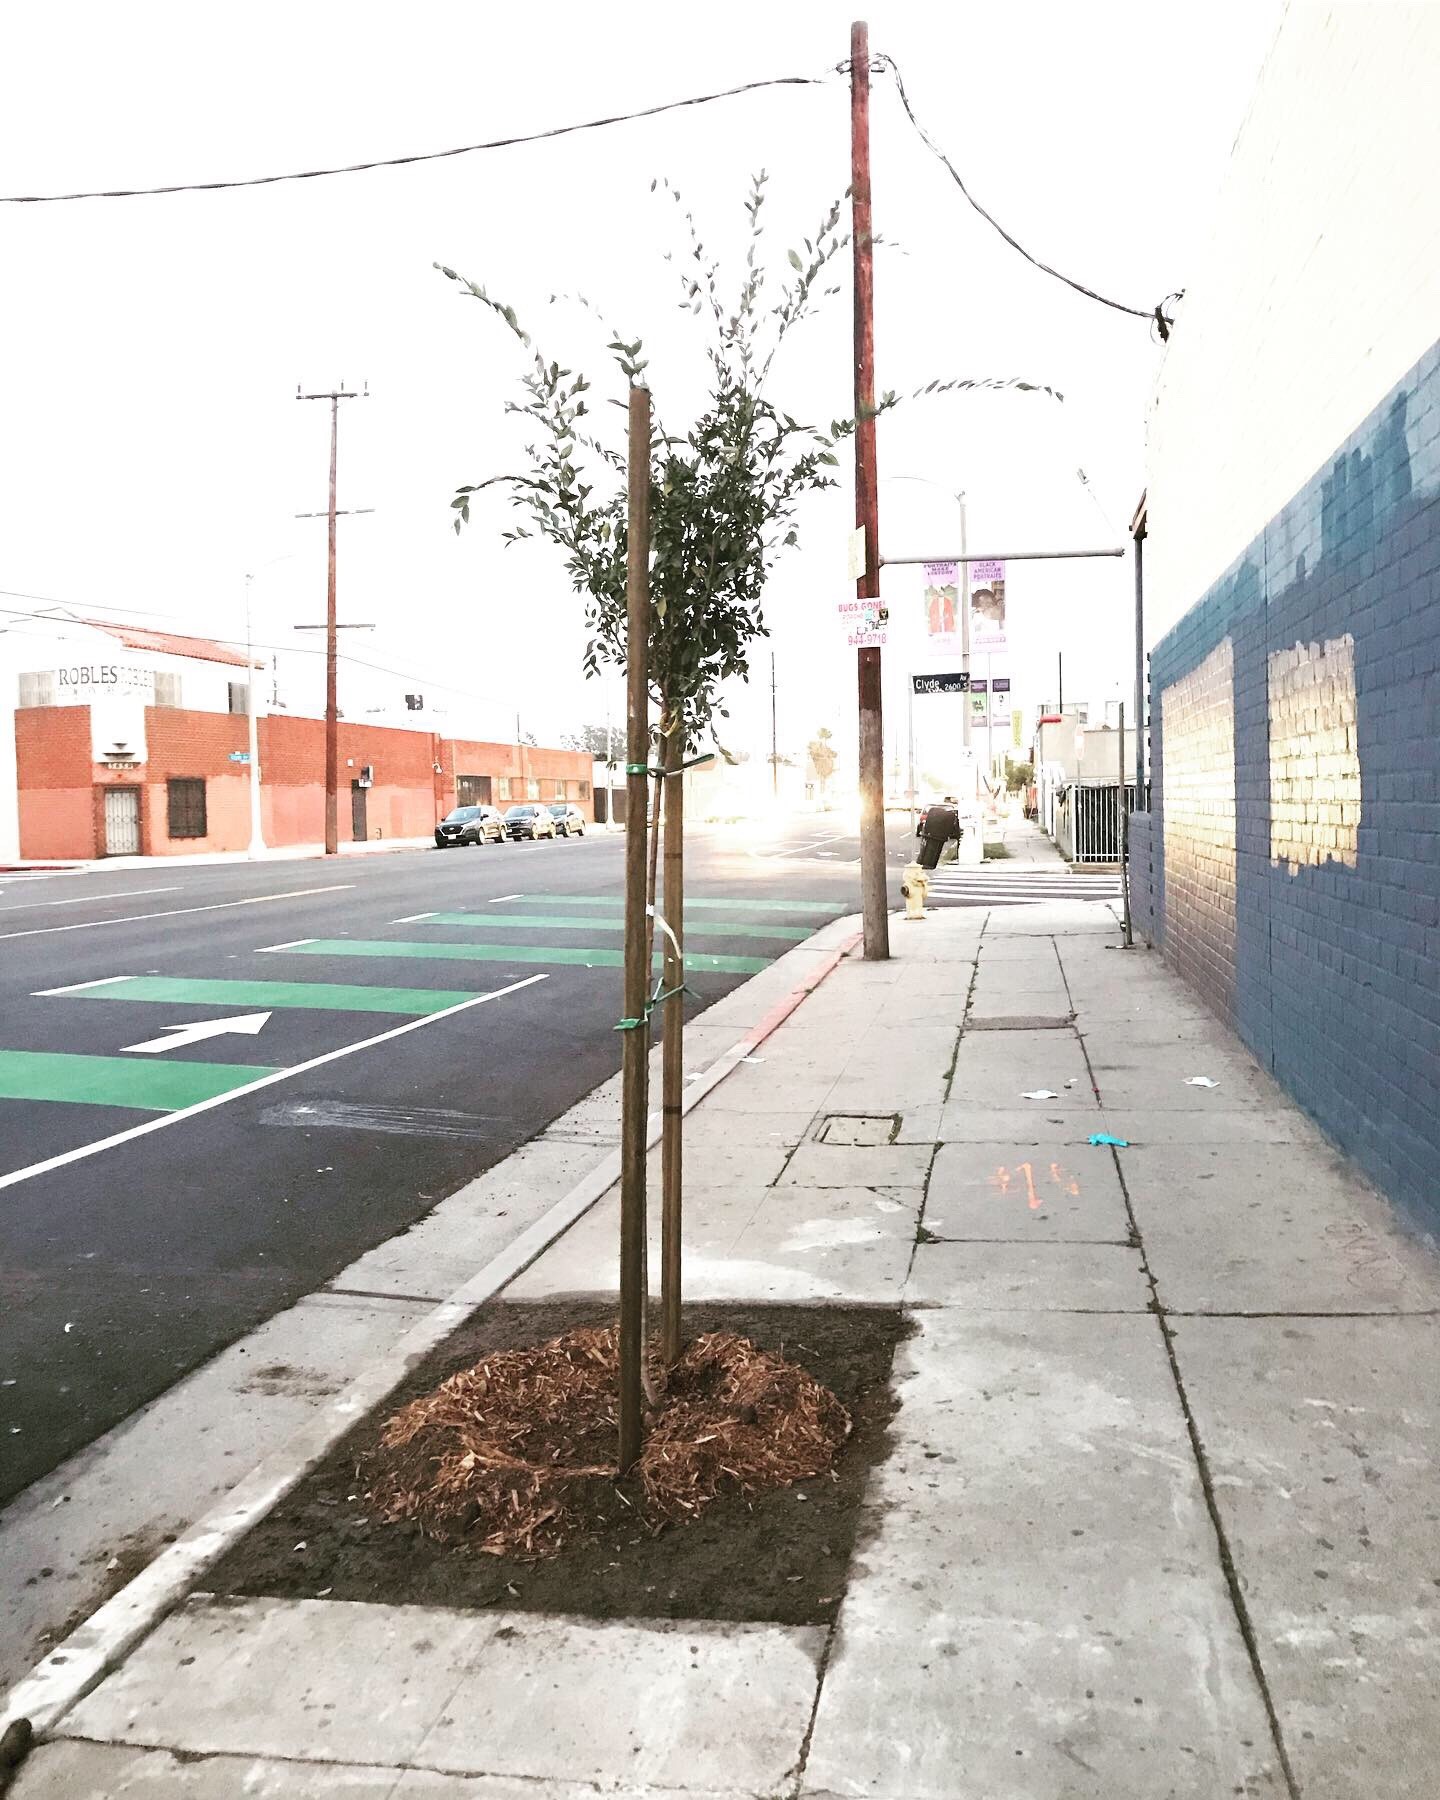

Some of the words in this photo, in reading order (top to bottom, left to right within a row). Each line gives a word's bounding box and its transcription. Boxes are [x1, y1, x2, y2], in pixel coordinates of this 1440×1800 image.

[838, 603, 858, 612] BUGS
[58, 665, 118, 685] ROBLES
[915, 679, 940, 691] Clyde
[944, 683, 961, 691] 2600
